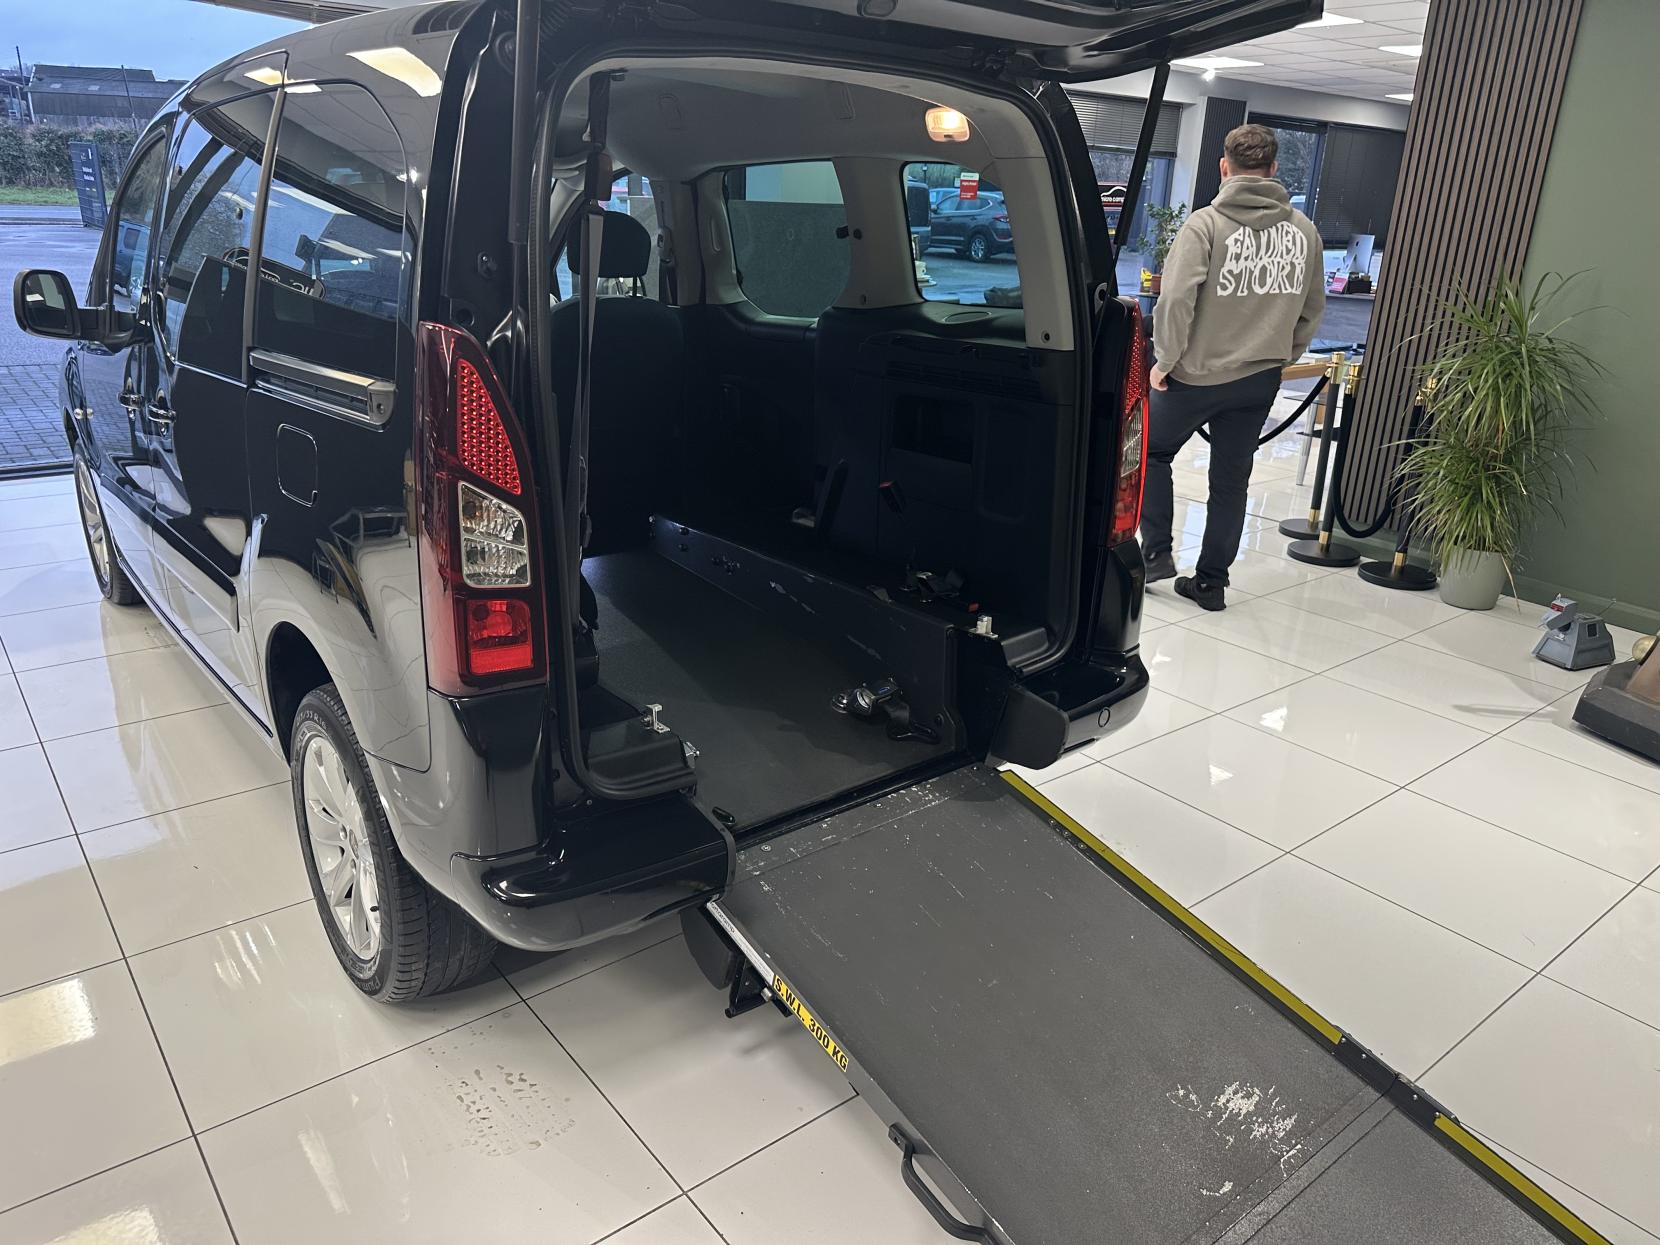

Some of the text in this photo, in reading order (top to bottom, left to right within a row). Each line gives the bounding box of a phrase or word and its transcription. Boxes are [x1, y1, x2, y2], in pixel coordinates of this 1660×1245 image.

[1217, 259, 1305, 296] STORE
[775, 978, 848, 1071] S.W.L. 300 KG
